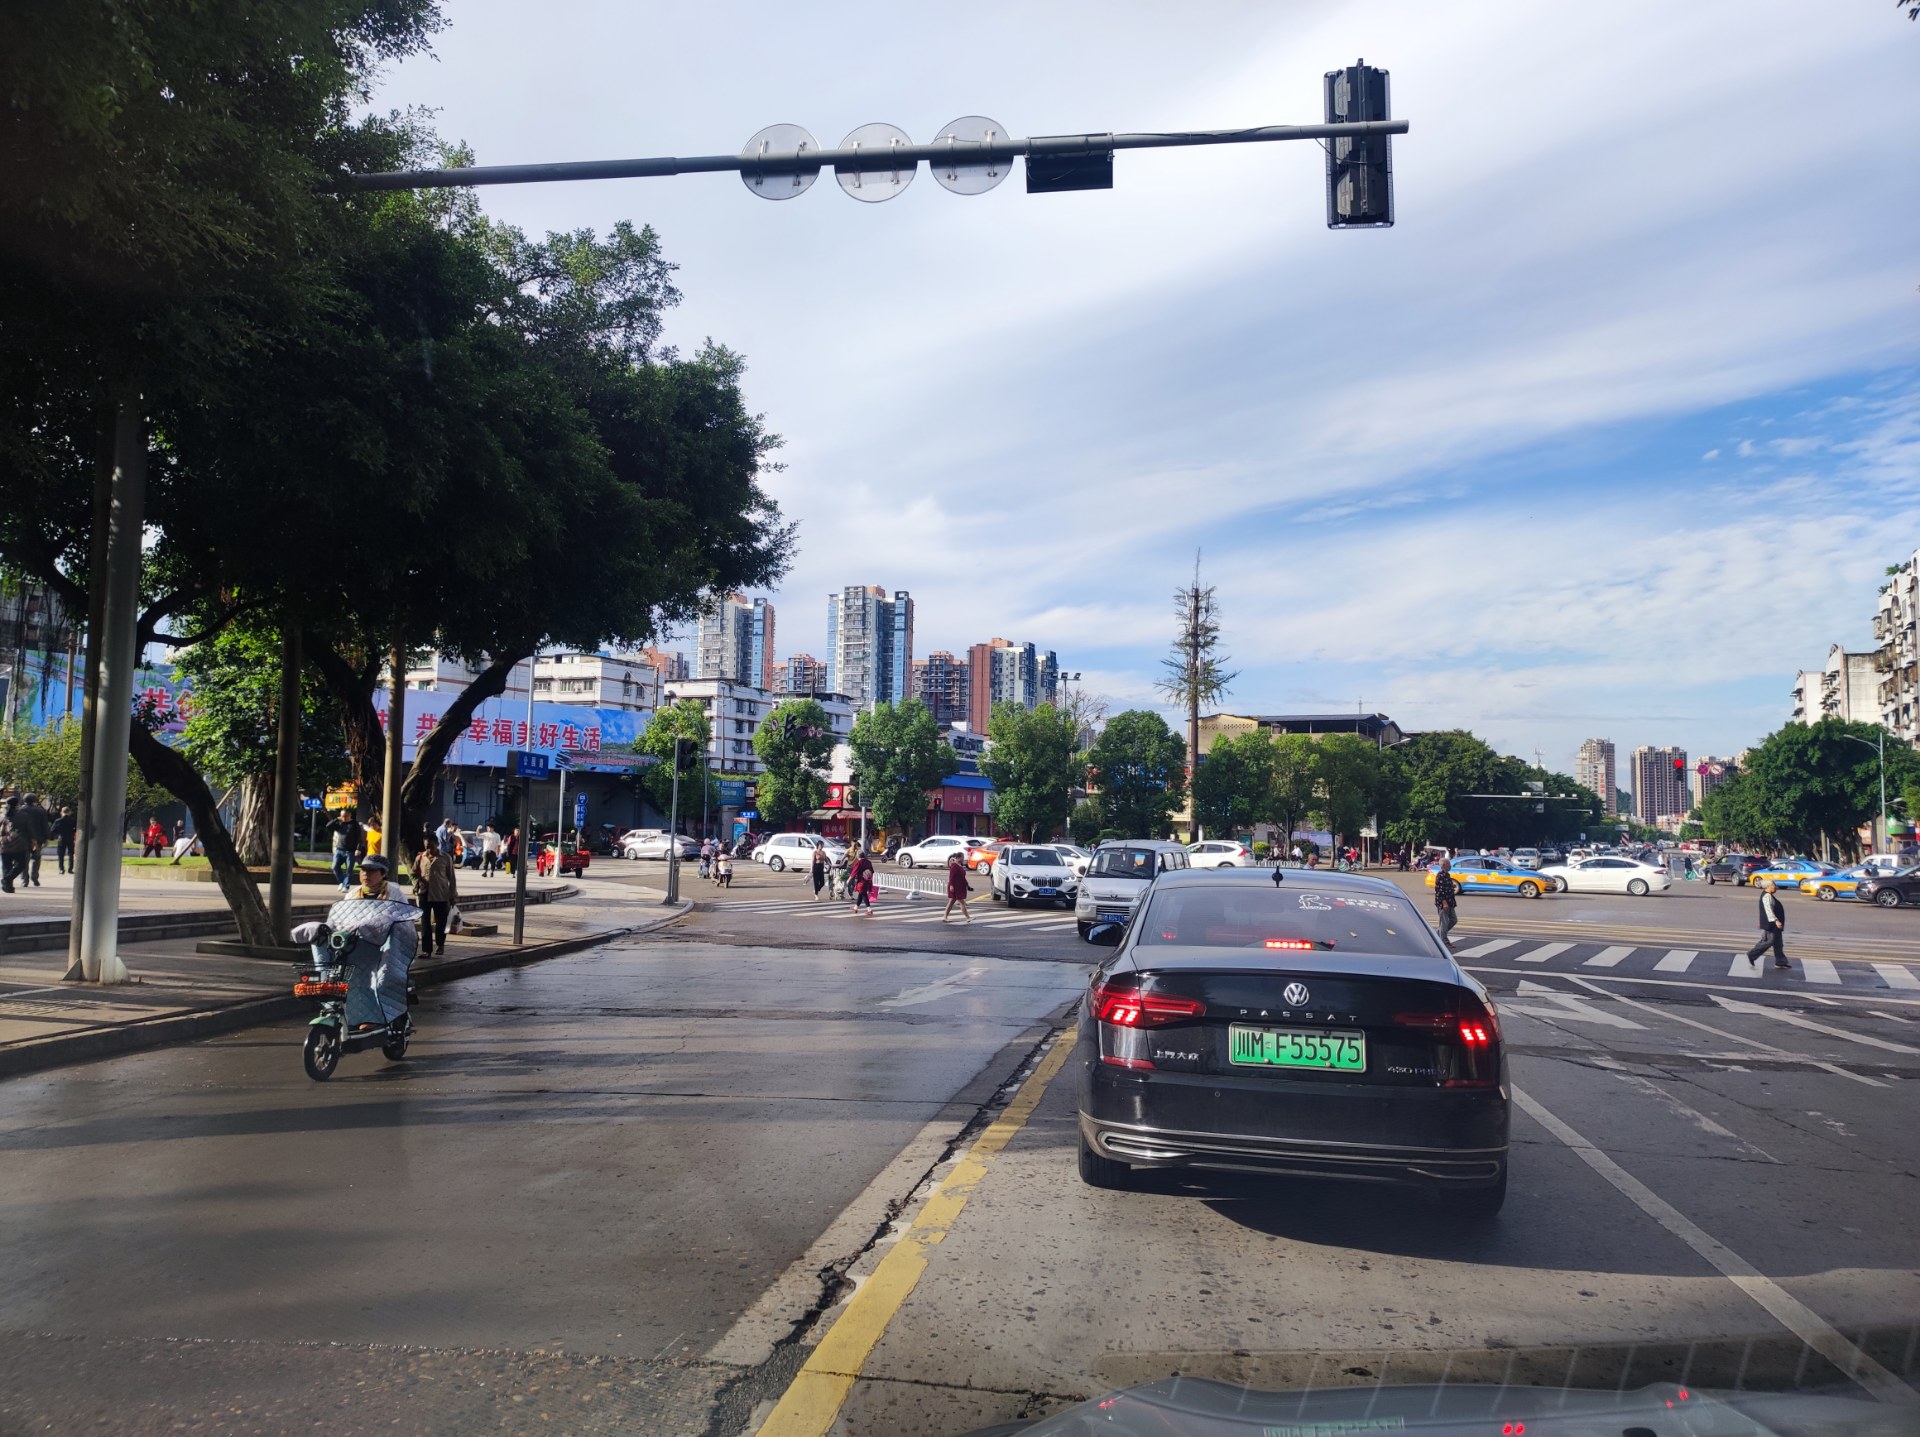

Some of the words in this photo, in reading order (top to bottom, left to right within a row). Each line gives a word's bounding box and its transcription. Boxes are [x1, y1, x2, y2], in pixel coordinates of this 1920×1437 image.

[415, 712, 602, 752] 共幸福美好生活
[1240, 1009, 1358, 1023] PASSAT
